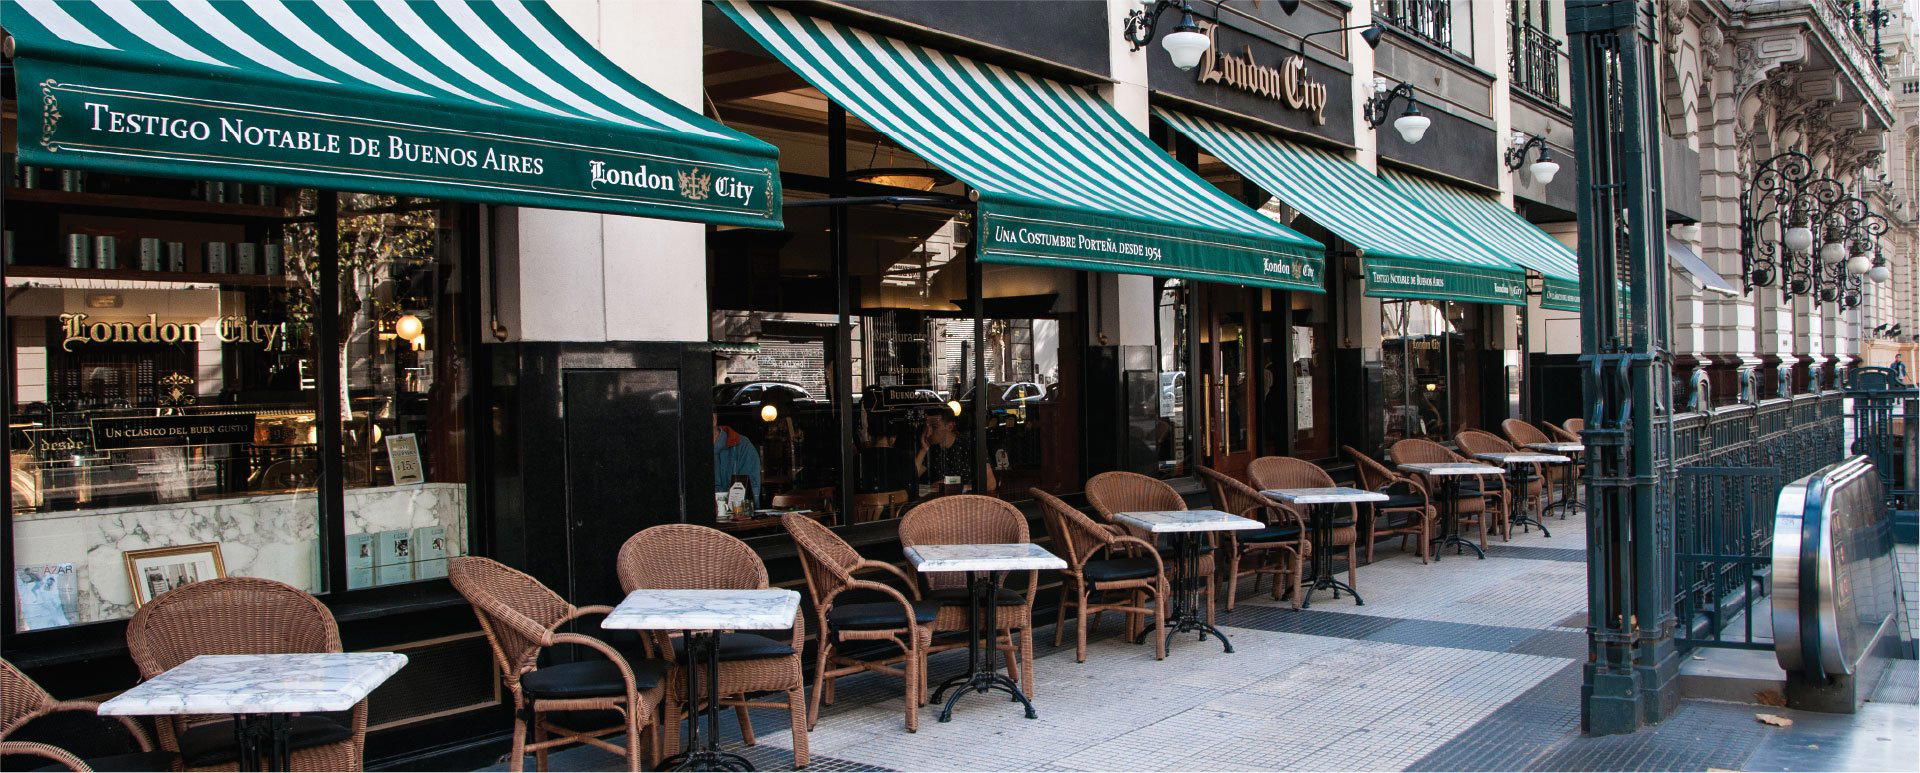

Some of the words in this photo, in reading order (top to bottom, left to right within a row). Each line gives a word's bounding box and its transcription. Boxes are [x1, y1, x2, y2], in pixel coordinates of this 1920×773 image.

[1197, 20, 1281, 100] London
[1280, 55, 1327, 126] City
[85, 101, 211, 141] TESTIGO
[219, 117, 341, 154] NOTABLE
[349, 137, 381, 158] DE
[387, 135, 478, 168] BUENOS
[482, 147, 544, 175] AIRES
[589, 160, 675, 192] London
[714, 175, 754, 205] City
[995, 225, 1018, 243] UNA
[1018, 228, 1076, 249] COSTUMBRE
[1078, 235, 1118, 253] PORTEÑA
[1119, 242, 1144, 256] DESDE
[1144, 246, 1162, 261] 1954
[1263, 257, 1290, 275] London
[1302, 264, 1315, 279] City
[59, 313, 202, 352] London
[214, 315, 281, 351] City
[41, 437, 84, 451] desde
[105, 428, 122, 438] UN
[169, 427, 188, 435] DEL
[190, 426, 215, 434] BUEN
[218, 424, 248, 433] GUSTO
